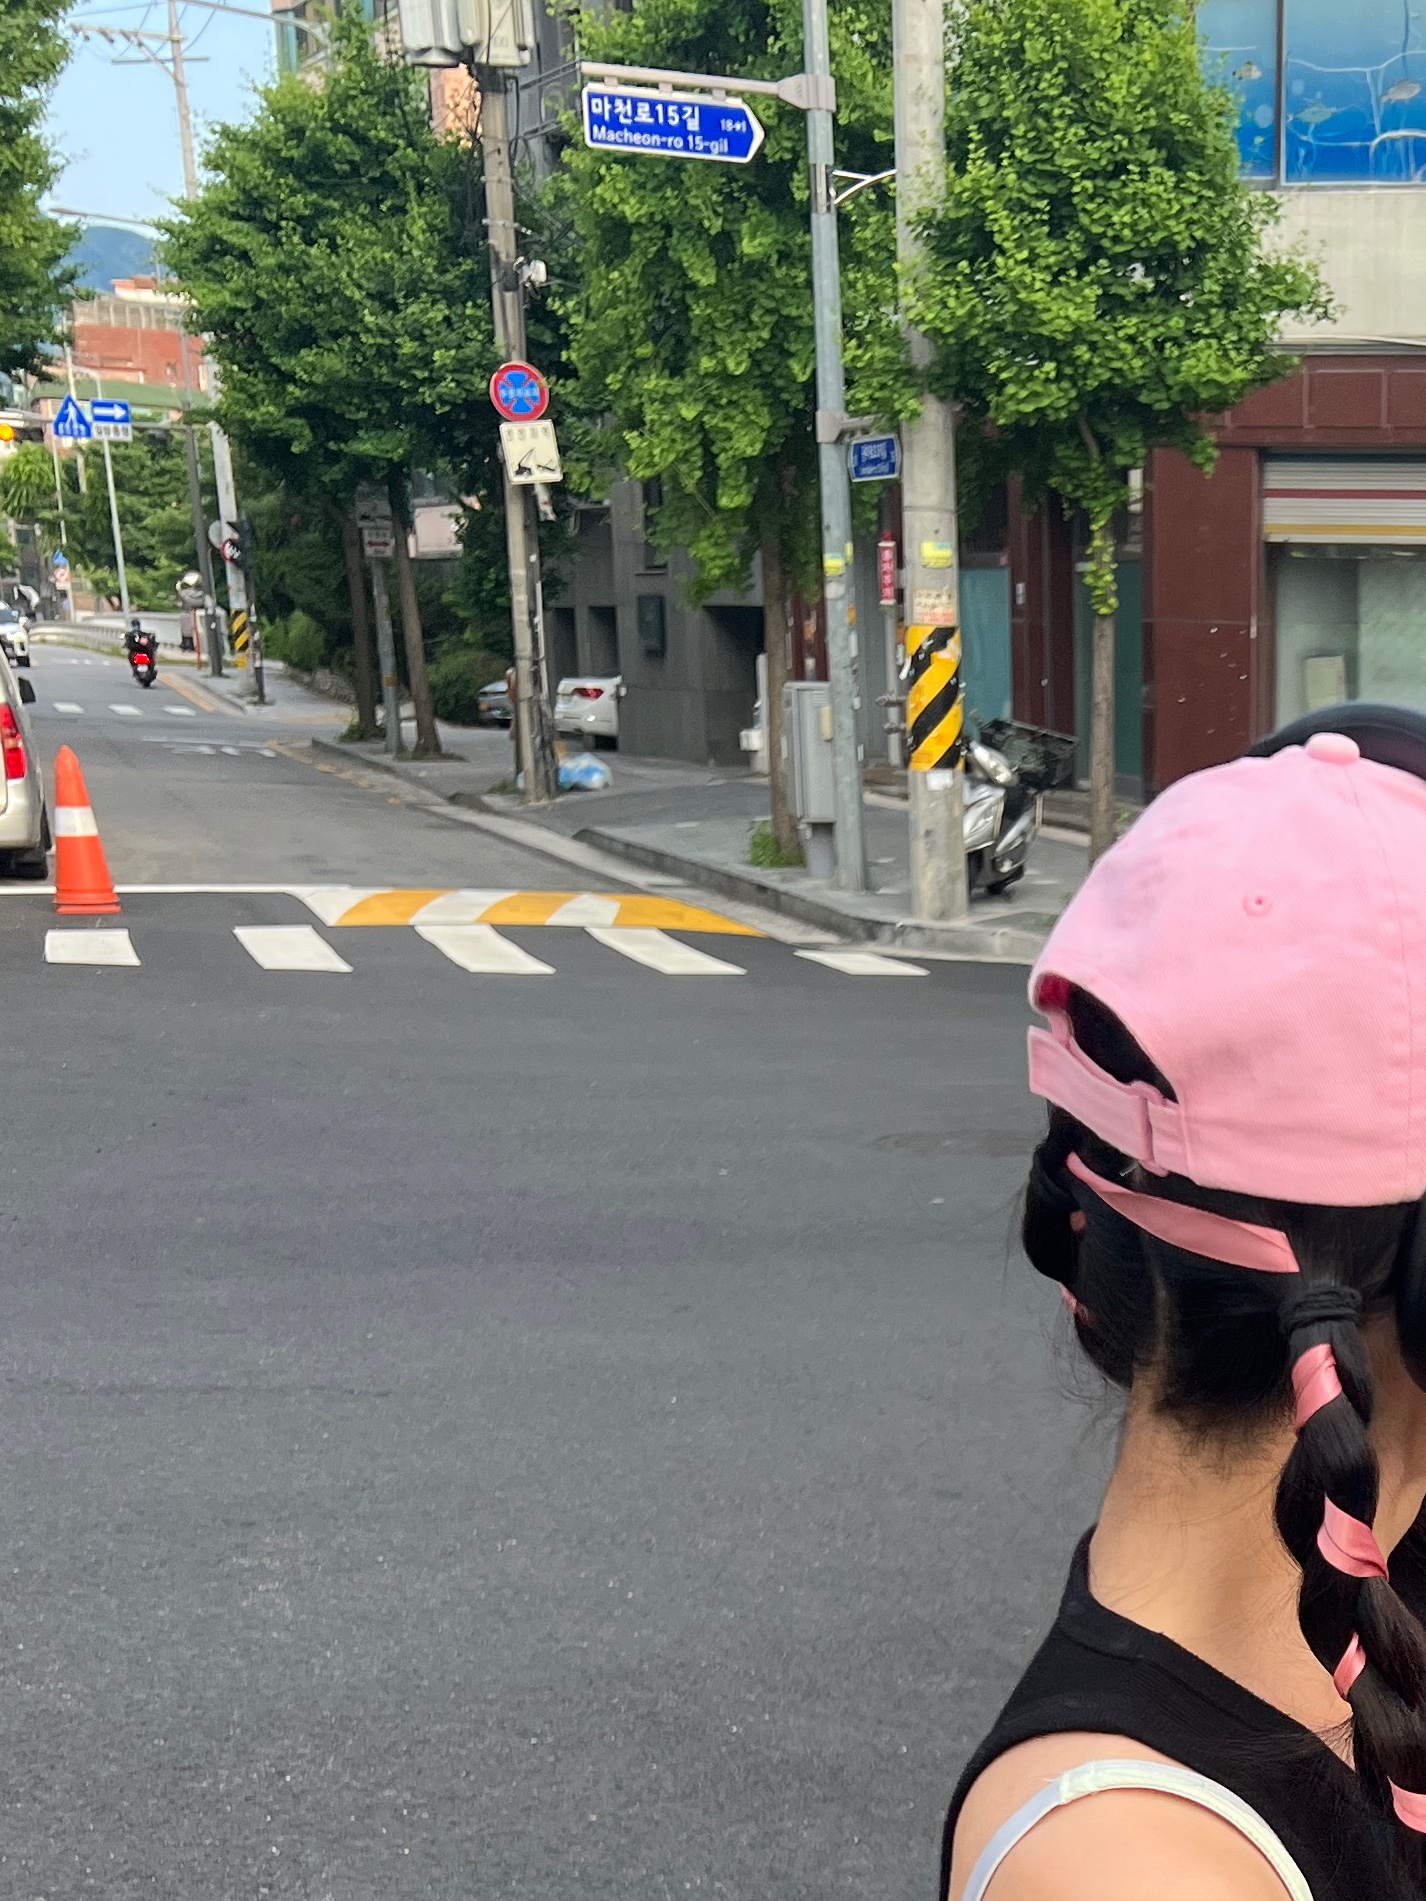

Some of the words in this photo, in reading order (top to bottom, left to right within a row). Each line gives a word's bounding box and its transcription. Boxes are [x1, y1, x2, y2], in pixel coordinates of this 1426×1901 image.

[590, 96, 700, 132] 마천로15길
[592, 124, 684, 147] Macheon-ro
[687, 134, 729, 155] 15-gil
